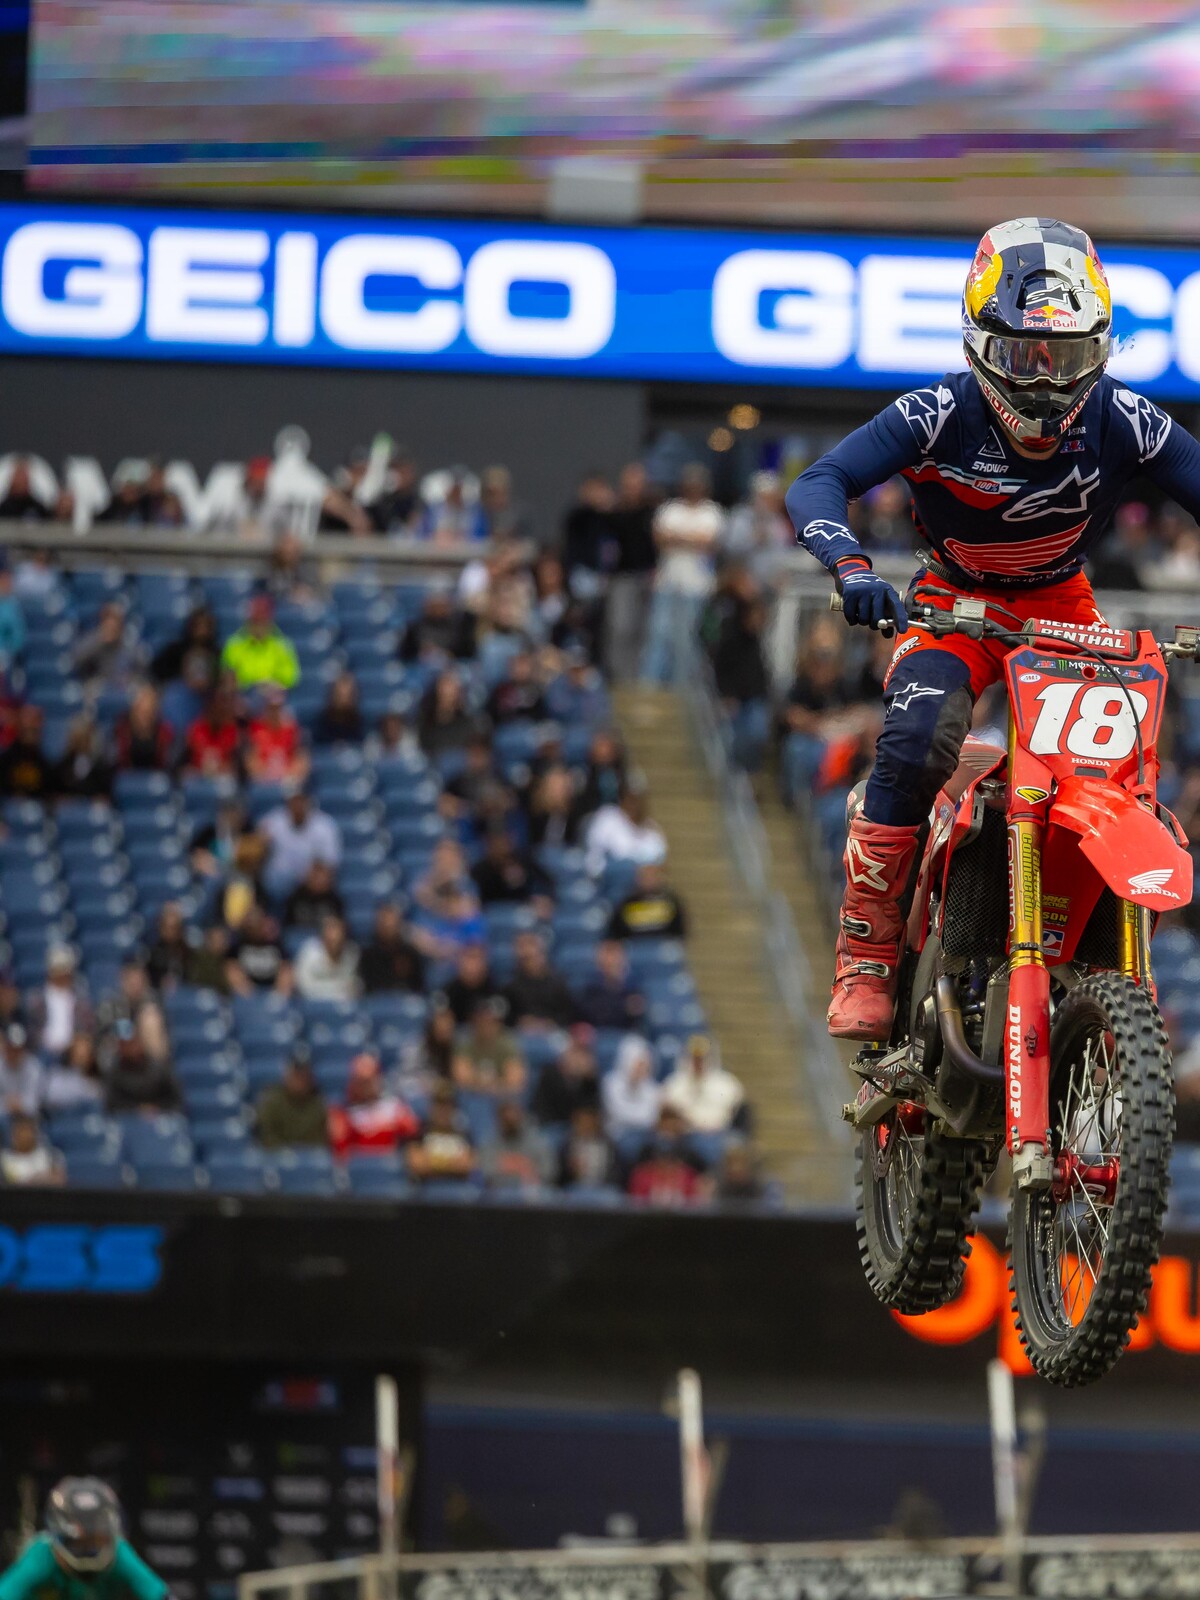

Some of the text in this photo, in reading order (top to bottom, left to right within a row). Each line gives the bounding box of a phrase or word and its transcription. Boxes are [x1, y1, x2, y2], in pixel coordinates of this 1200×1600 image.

[2, 221, 616, 359] GEICO
[1023, 319, 1077, 328] Red Bull
[972, 461, 1009, 473] SHOWA
[976, 481, 999, 492] 100%
[1040, 628, 1126, 649] RENTHAL
[1029, 682, 1149, 760] 18
[1071, 757, 1112, 768] HONDA
[1130, 888, 1181, 900] HONDA
[1009, 1004, 1022, 1119] DUNLOP
